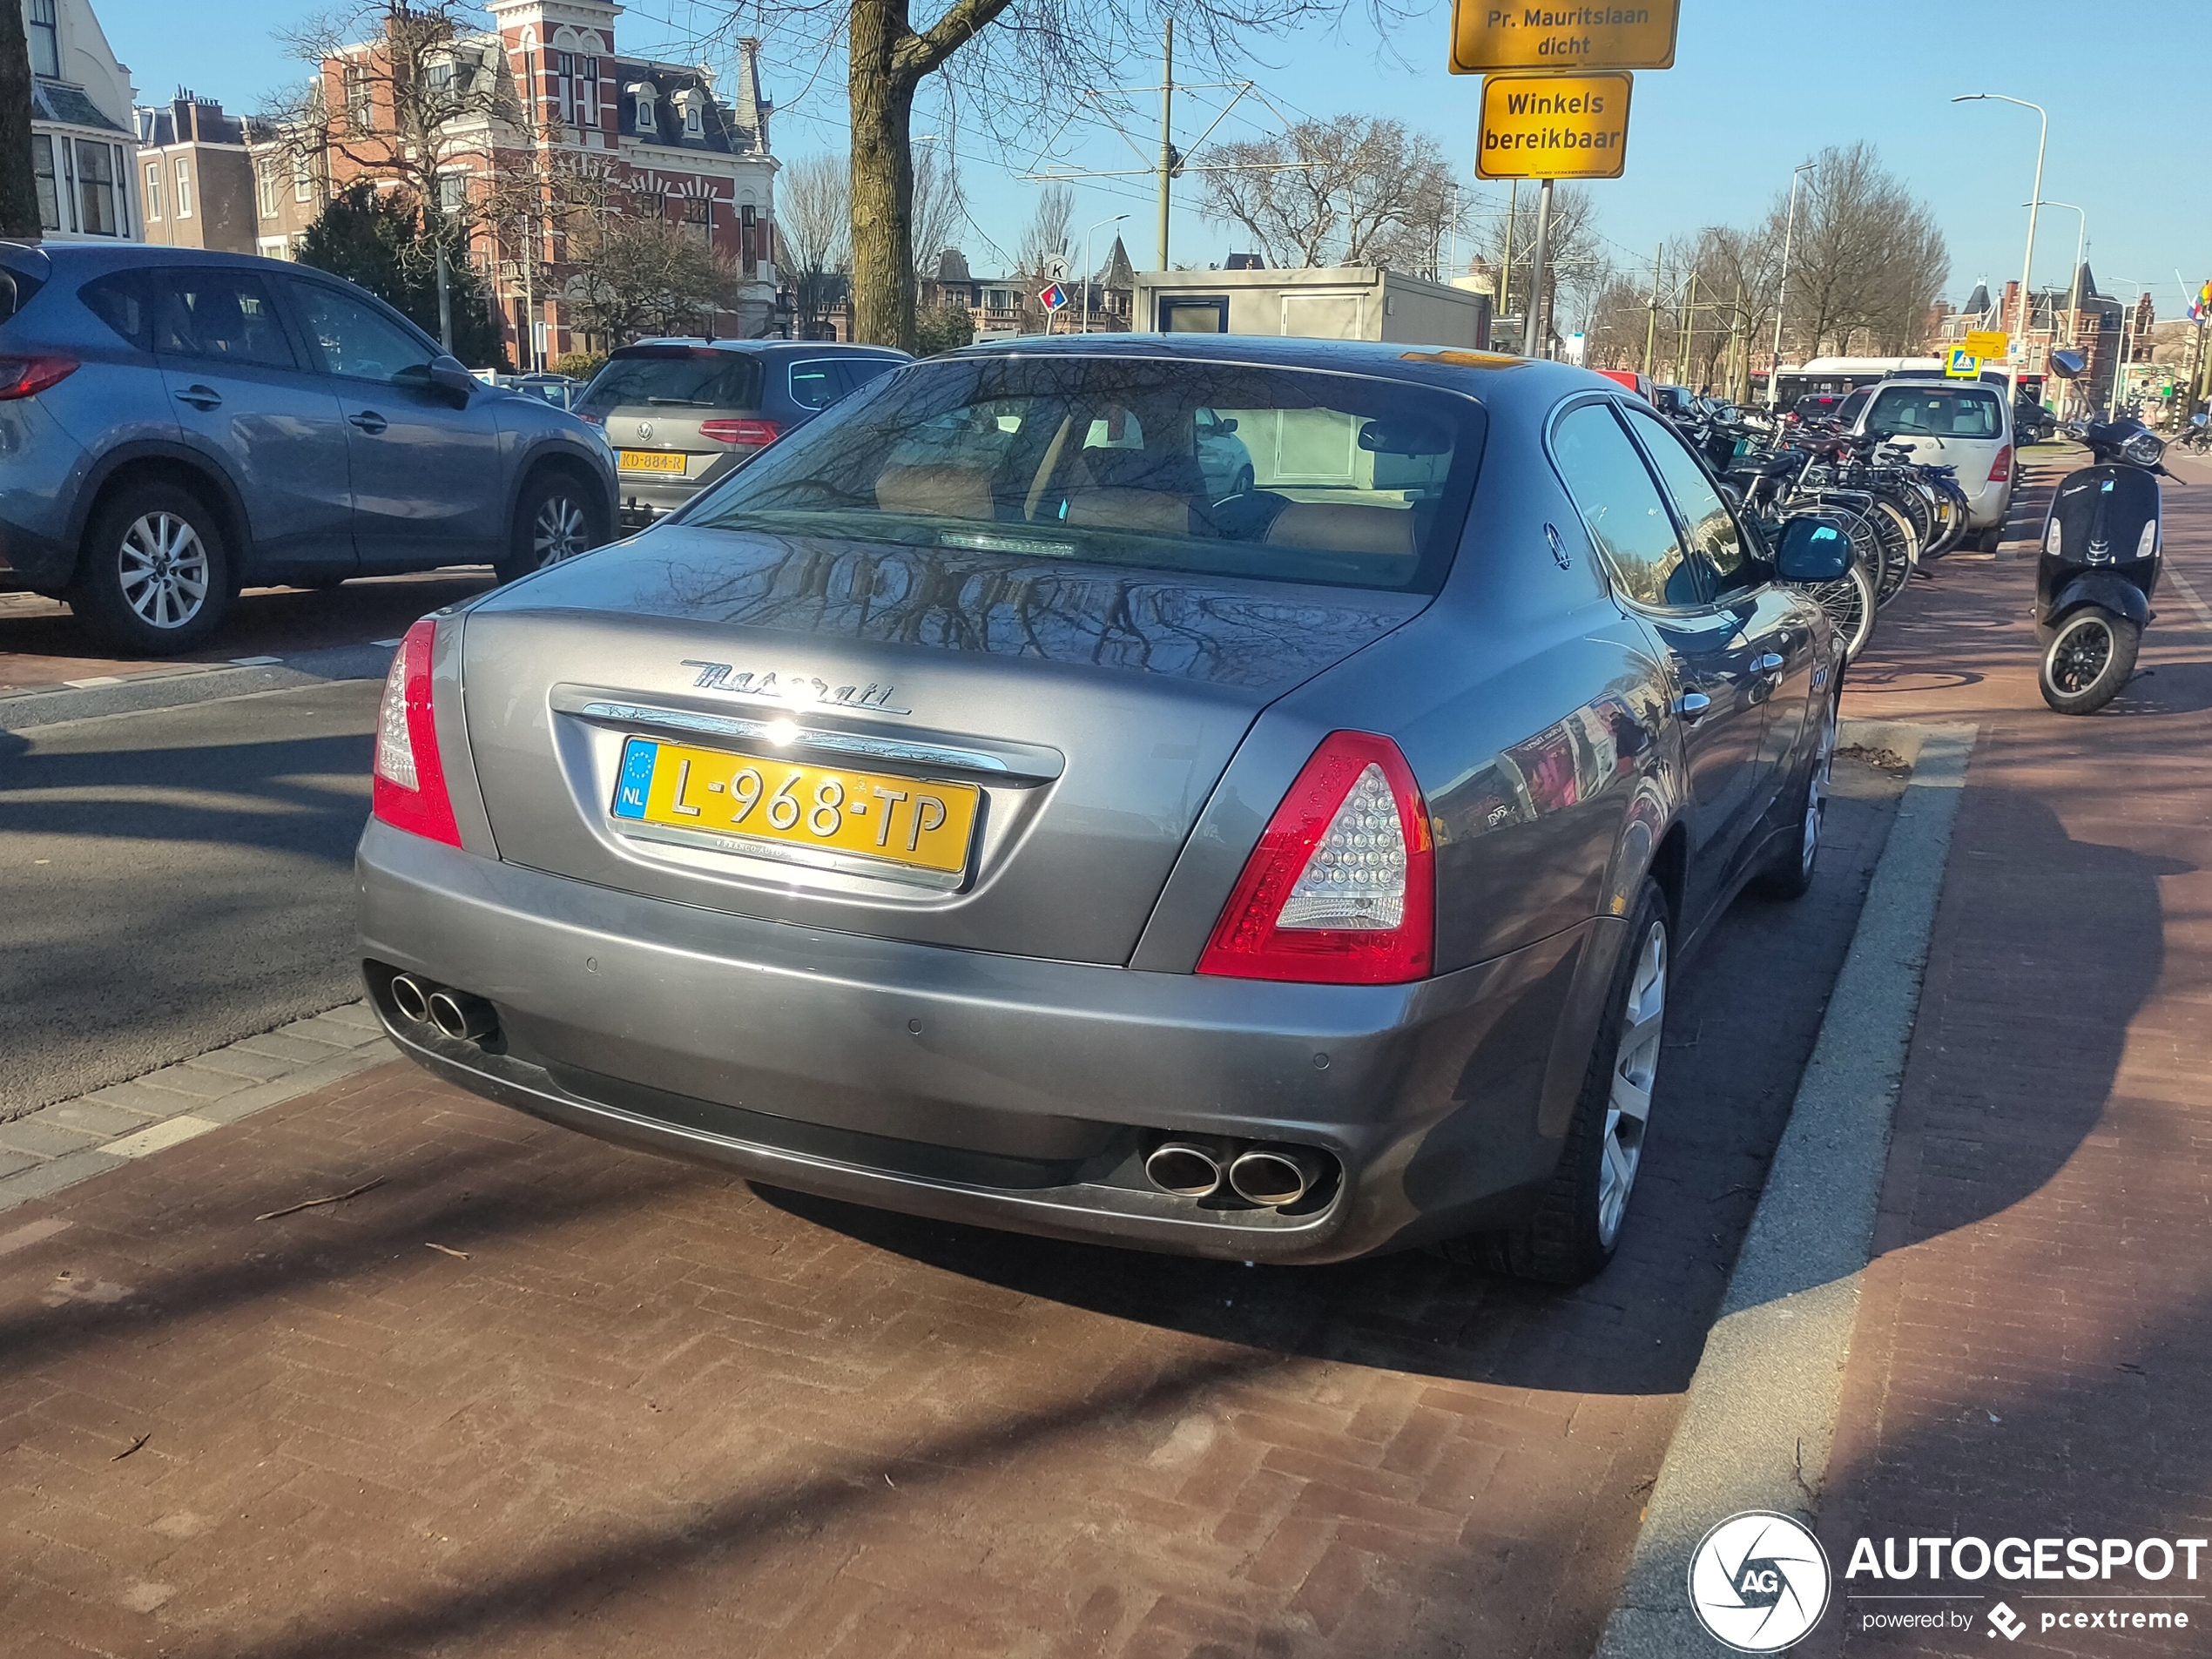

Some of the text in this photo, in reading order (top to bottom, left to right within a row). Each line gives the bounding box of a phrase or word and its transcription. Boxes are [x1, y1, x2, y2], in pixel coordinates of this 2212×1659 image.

[1487, 6, 1649, 29] Pr. Mauritslaan
[1538, 37, 1591, 56] dicht
[1507, 91, 1604, 115] Winkels
[1486, 127, 1621, 150] bereikbaar
[1052, 264, 1064, 278] K
[623, 454, 681, 469] KD-884-R
[622, 786, 644, 806] NL
[671, 758, 948, 853] L-968-TP
[723, 840, 757, 853] FRANCO
